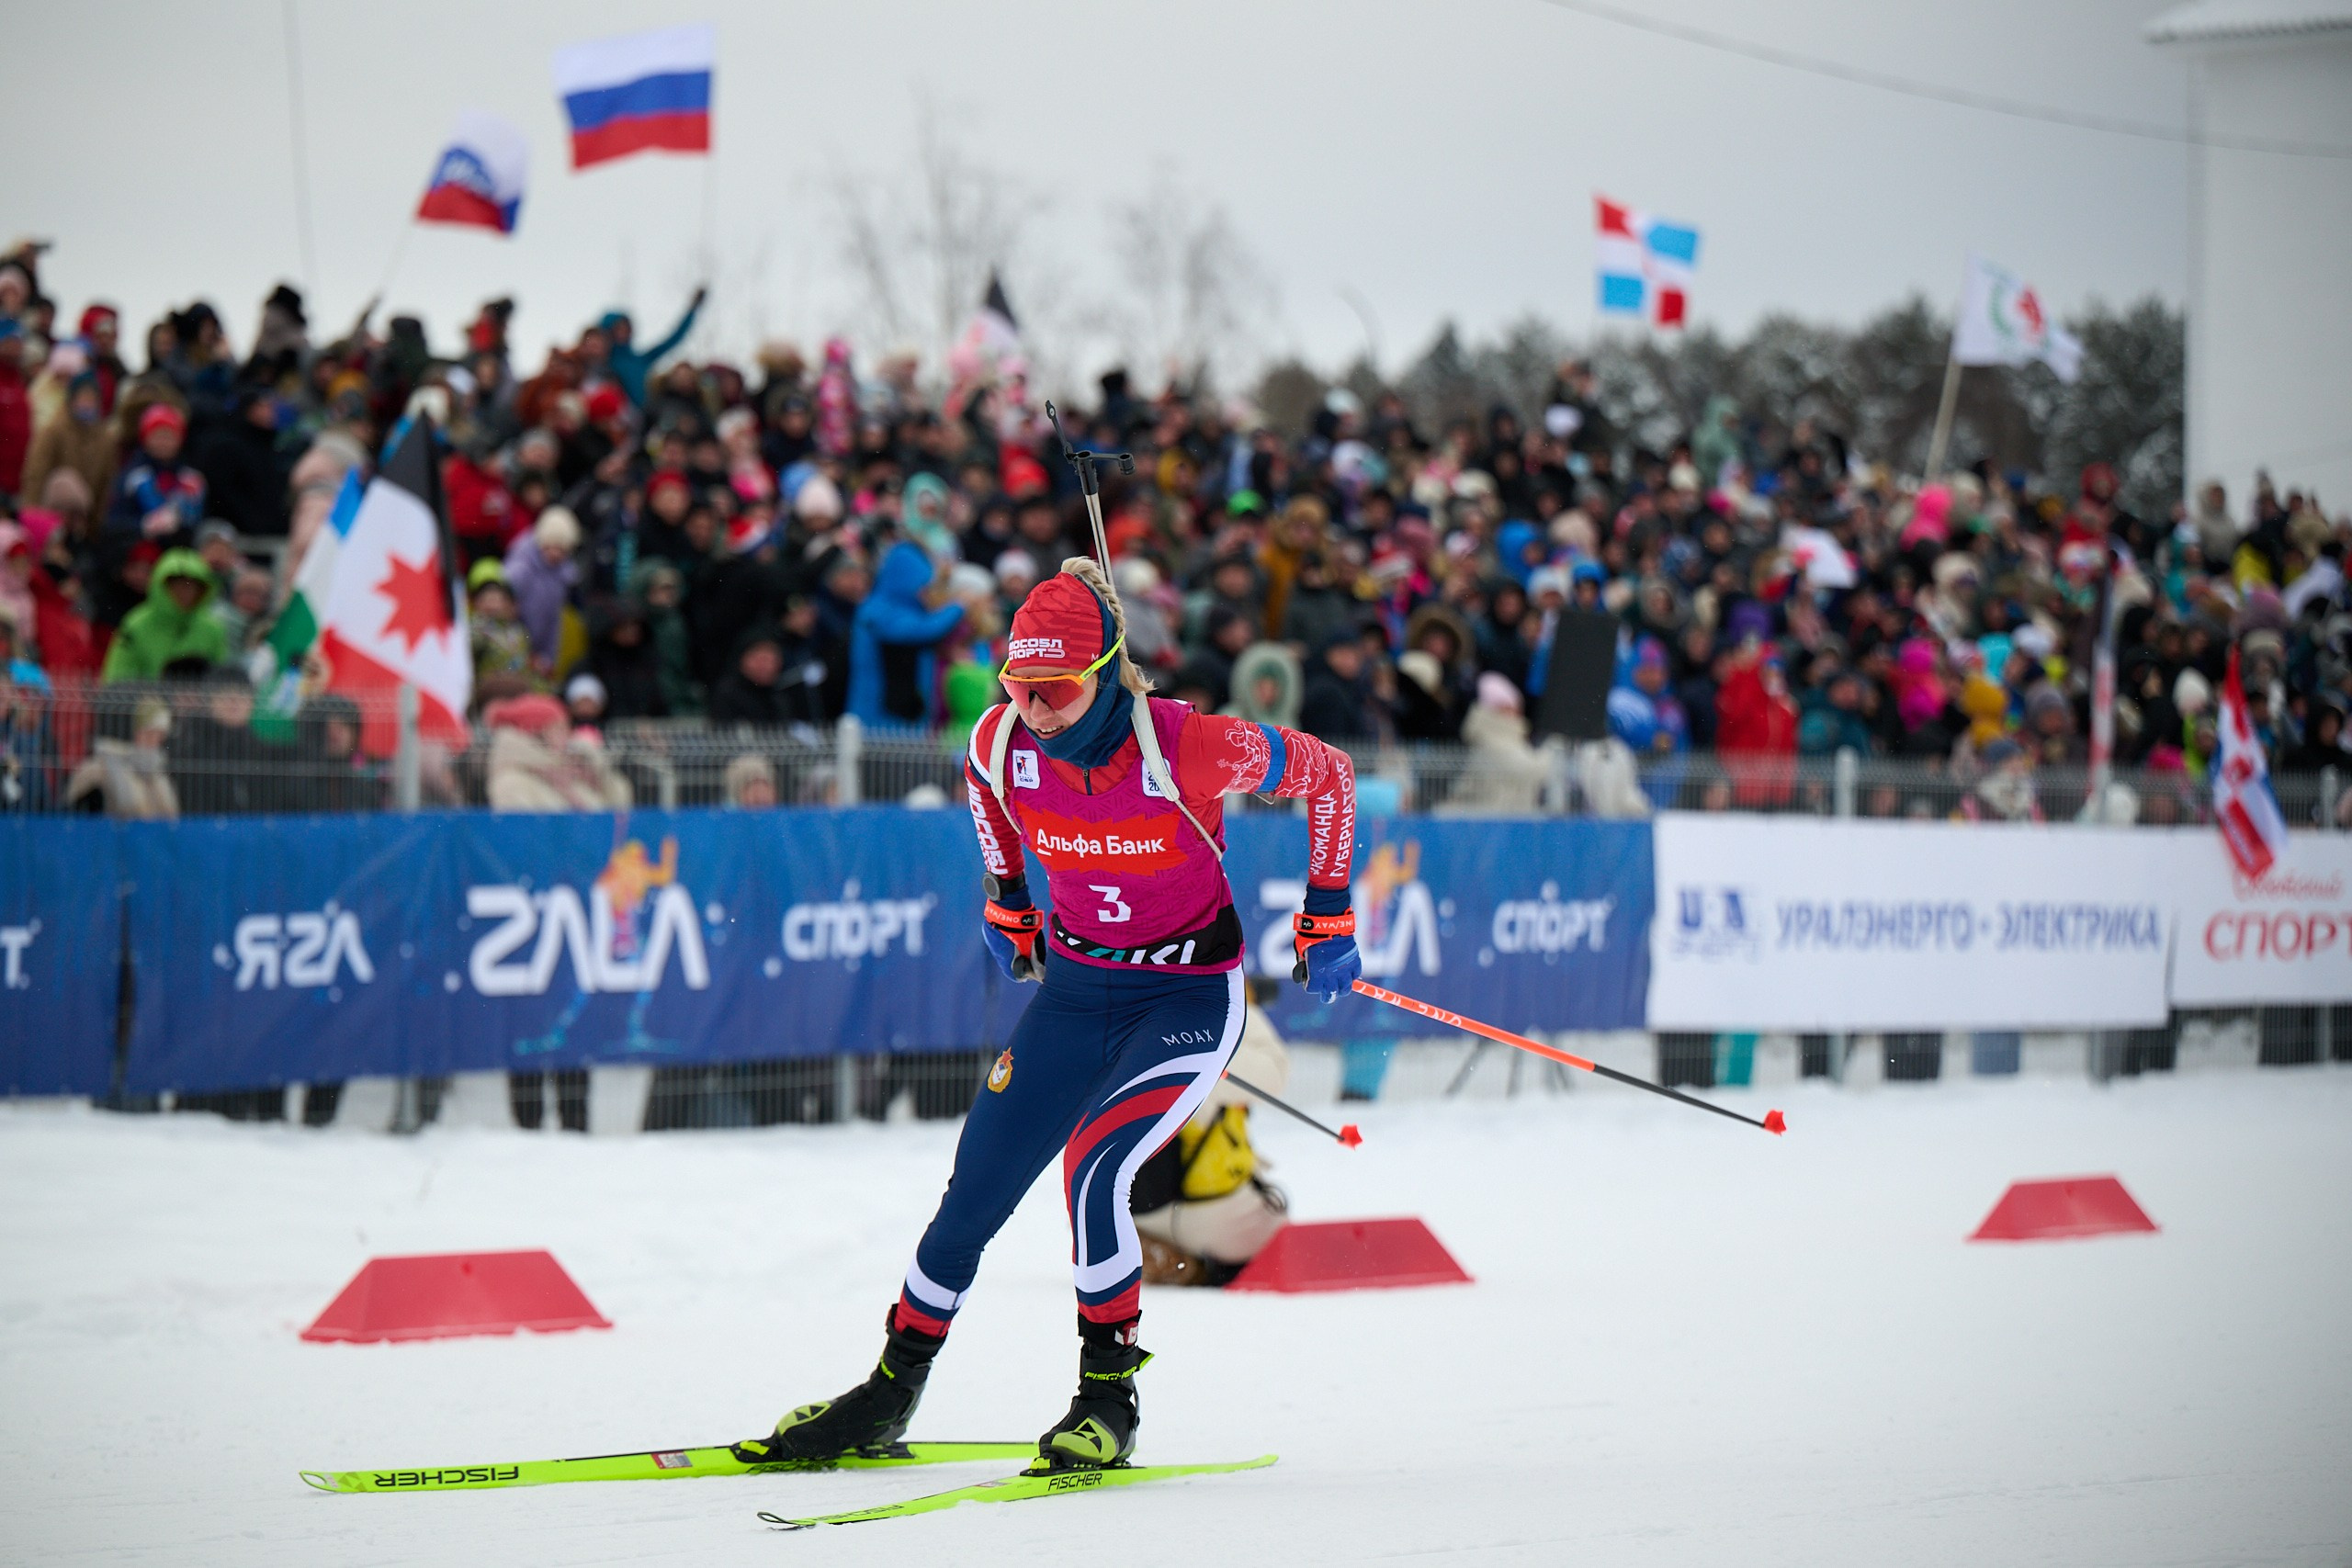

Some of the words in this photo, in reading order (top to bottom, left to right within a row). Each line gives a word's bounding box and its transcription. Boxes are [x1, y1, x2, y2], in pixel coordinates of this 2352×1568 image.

[1036, 828, 1103, 858] Альфа
[1105, 834, 1167, 855] Банк
[1088, 884, 1132, 923] 3
[782, 899, 928, 961] СПОРТ
[1492, 897, 1610, 955] СПОРТ
[1160, 1029, 1215, 1047] MOAX
[1084, 1366, 1137, 1381] FISCHER
[374, 1466, 519, 1487] FISCHER
[1047, 1472, 1102, 1492] FISCHER
